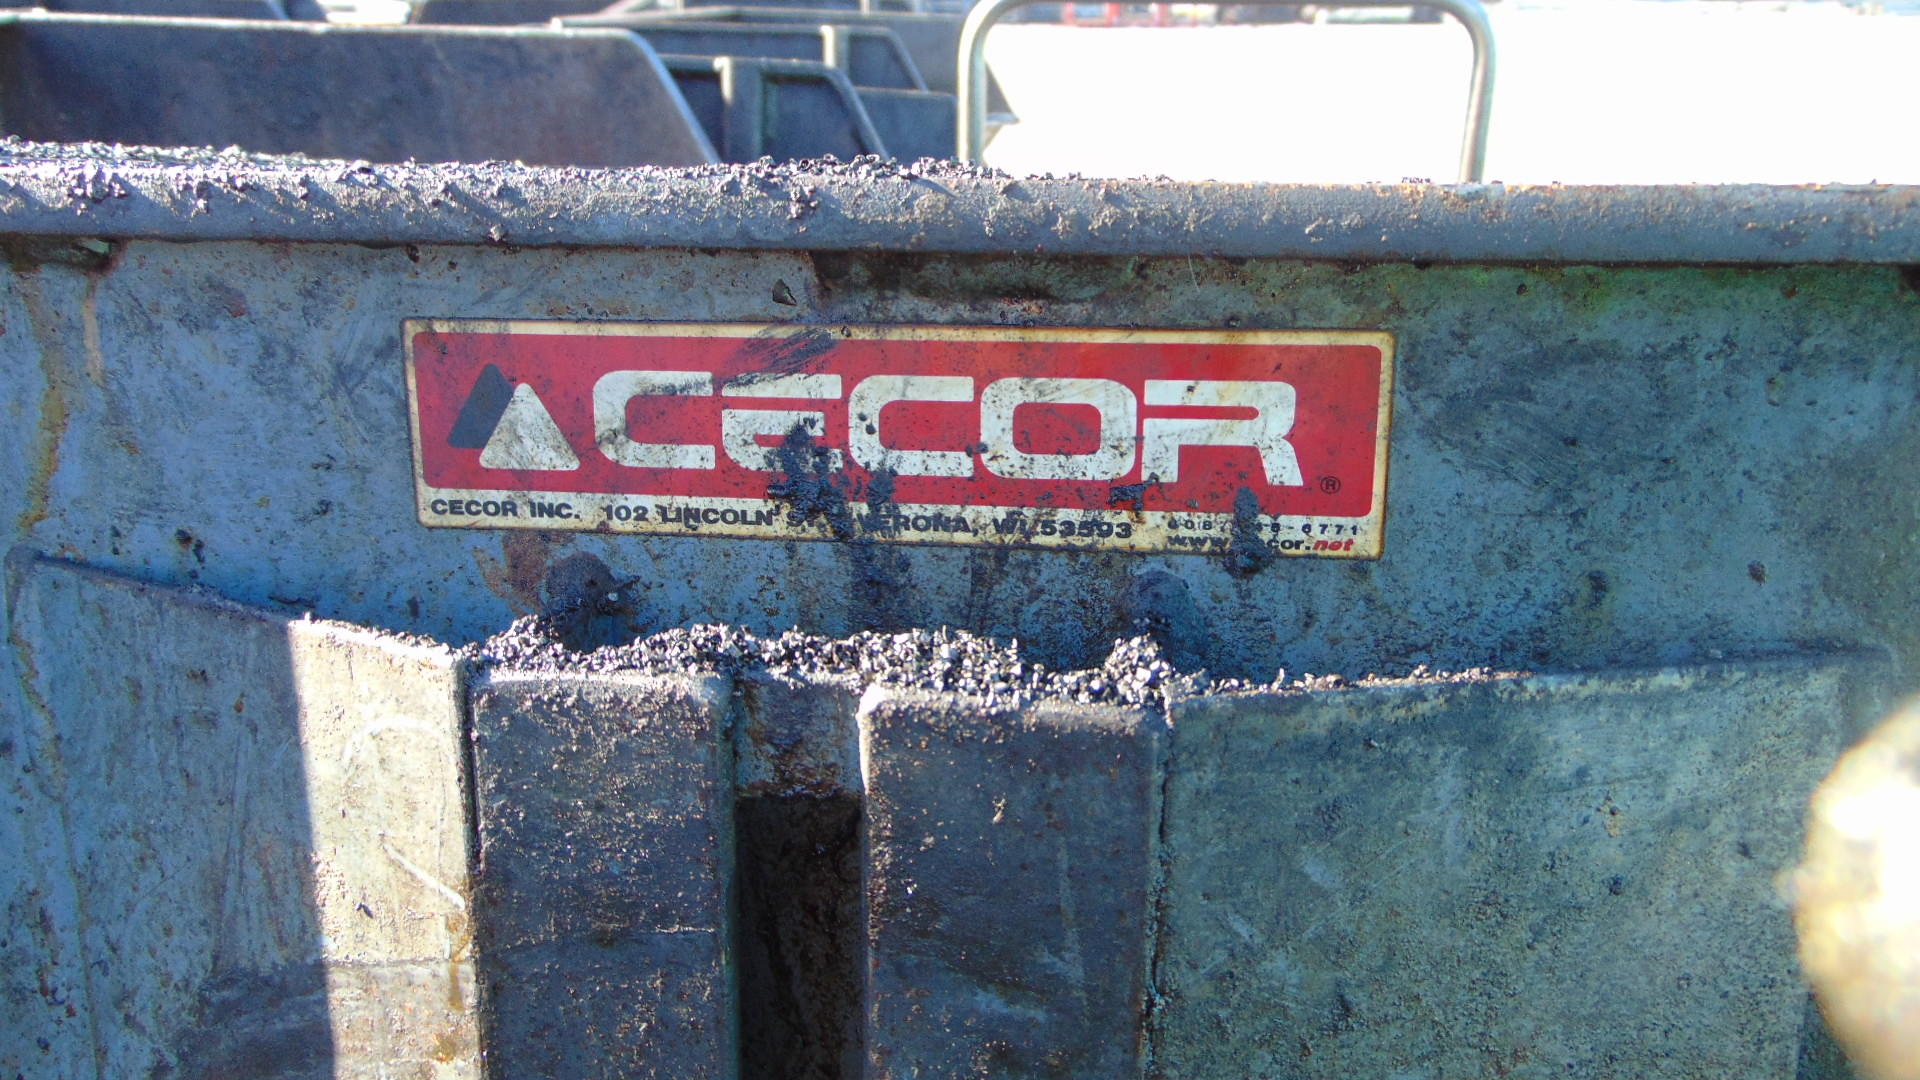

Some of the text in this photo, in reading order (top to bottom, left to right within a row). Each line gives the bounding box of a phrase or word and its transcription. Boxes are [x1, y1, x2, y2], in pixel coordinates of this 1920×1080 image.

[592, 369, 1306, 487] CECOR
[431, 498, 519, 518] CECOR
[529, 501, 581, 519] INC.
[601, 505, 650, 522] 102
[660, 506, 773, 526] LINCOLN
[856, 512, 979, 537] VERONA,
[1040, 520, 1132, 539] 53593
